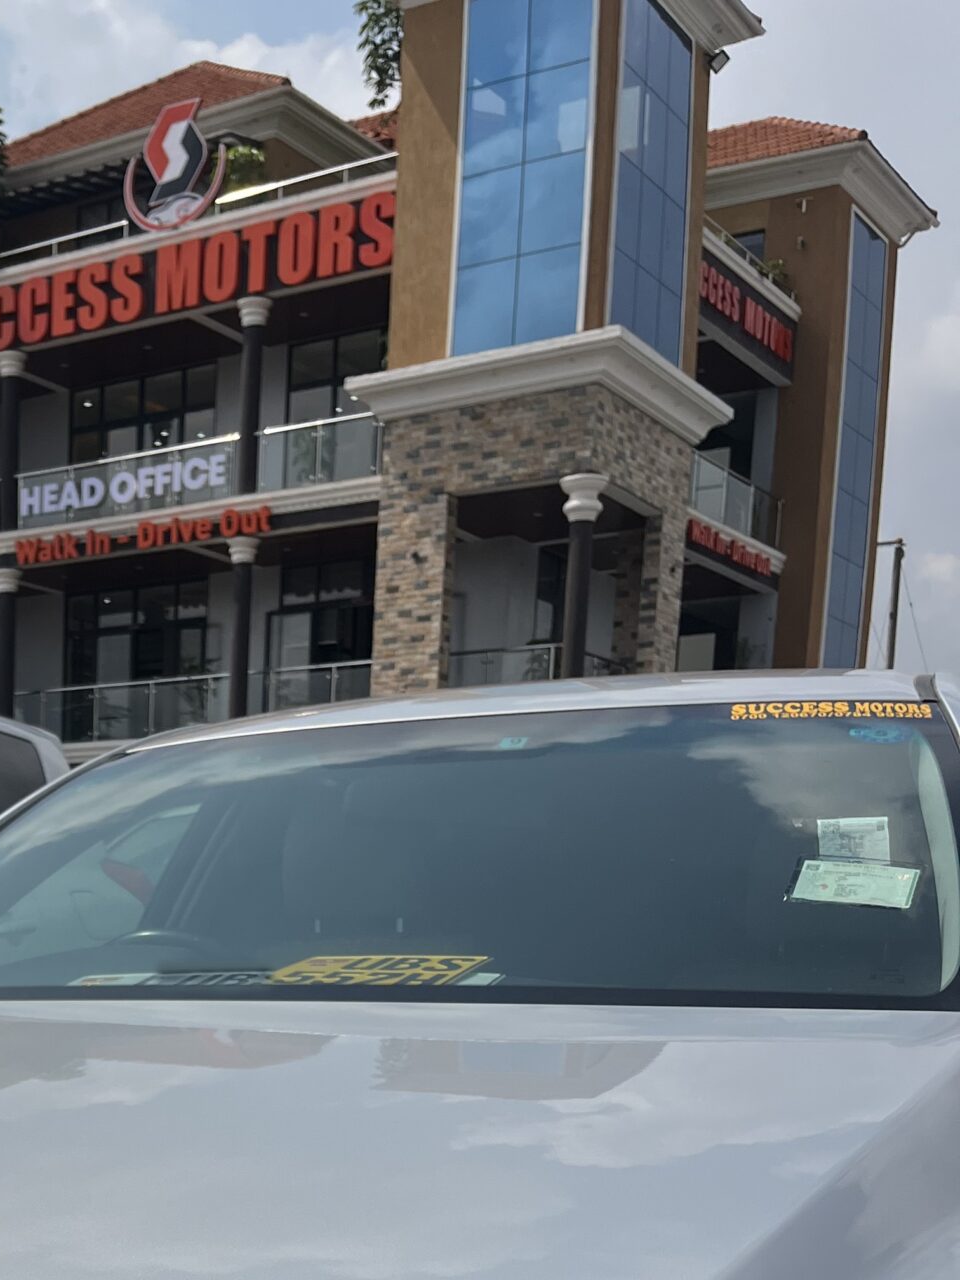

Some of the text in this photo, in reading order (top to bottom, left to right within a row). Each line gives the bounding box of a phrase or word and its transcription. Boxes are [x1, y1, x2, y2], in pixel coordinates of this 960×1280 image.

[155, 191, 397, 315] MOTORS
[19, 454, 227, 517] HEAD OFFICE
[15, 531, 80, 565] Walk
[85, 529, 111, 556] In
[135, 517, 215, 551] Drive
[219, 506, 273, 538] Out
[731, 702, 932, 716] SUCCESS MOTORS
[273, 971, 448, 986] 552H
[341, 957, 477, 972] UBS
